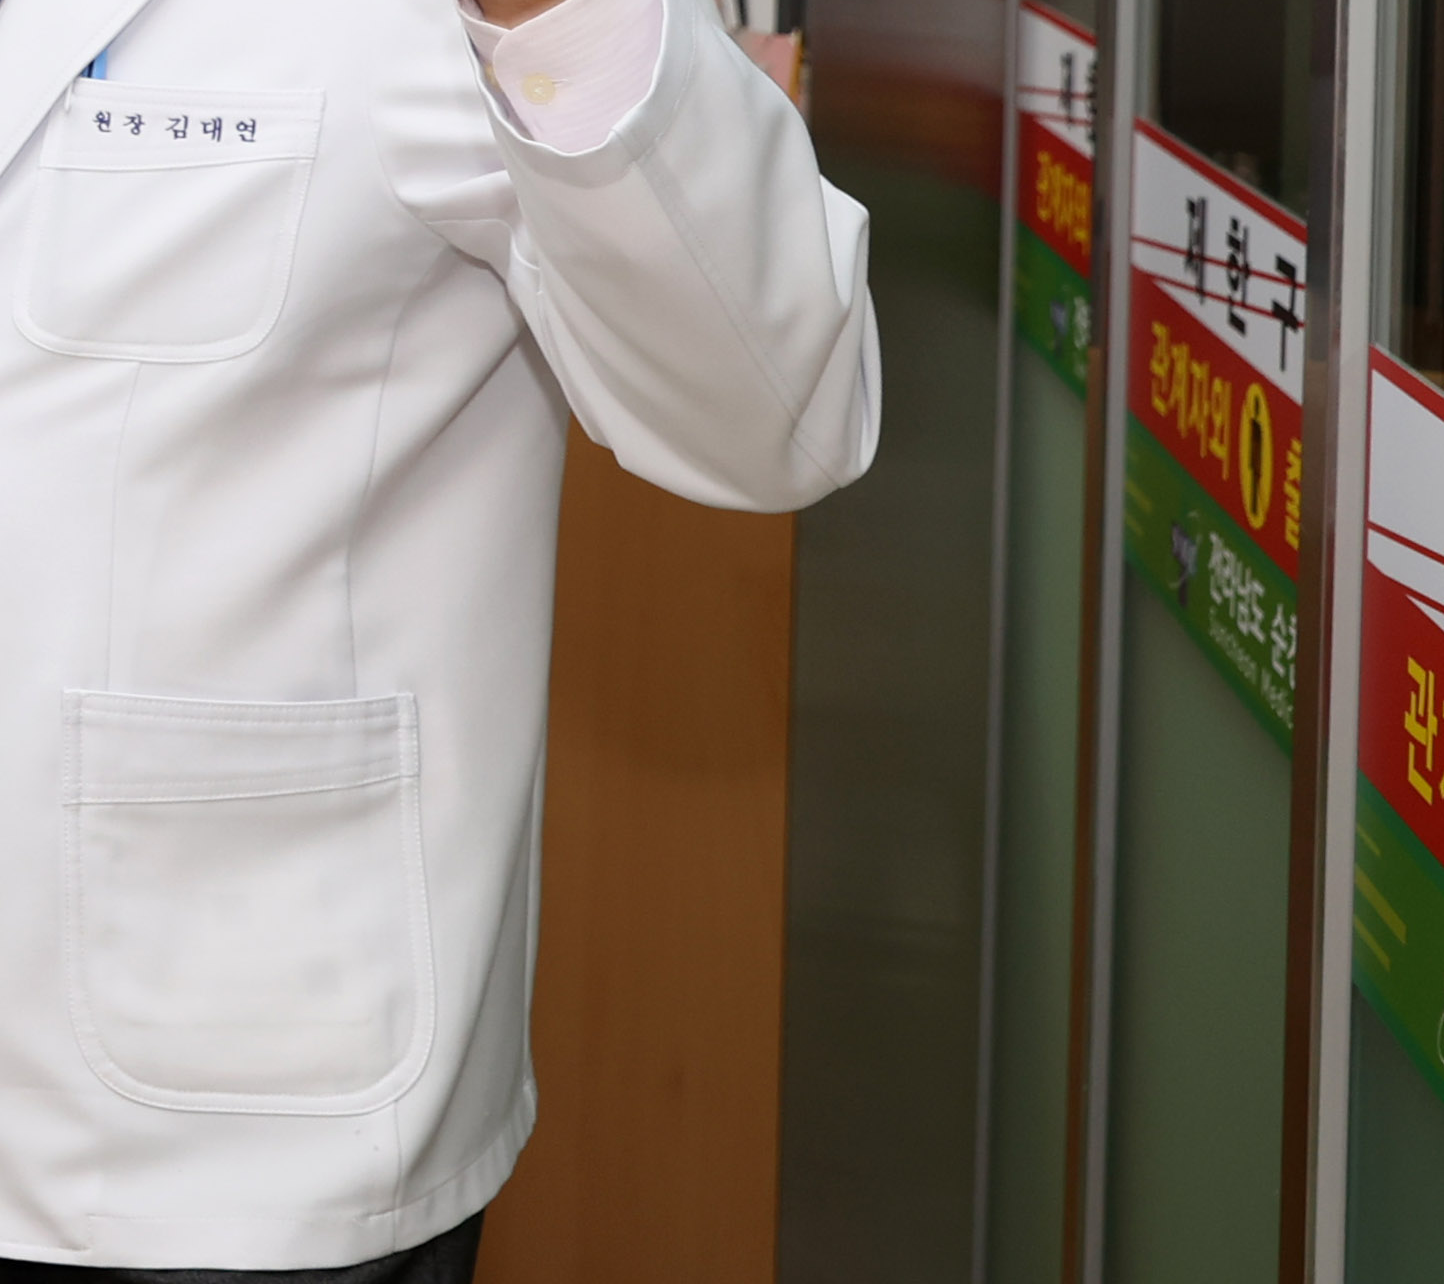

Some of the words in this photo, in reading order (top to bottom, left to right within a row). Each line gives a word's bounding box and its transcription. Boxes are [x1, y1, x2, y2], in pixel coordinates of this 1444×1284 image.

[92, 110, 146, 136] 원장
[164, 115, 258, 143] 김대연
[1150, 320, 1232, 482] 관계자외
[1404, 656, 1444, 806] 관
